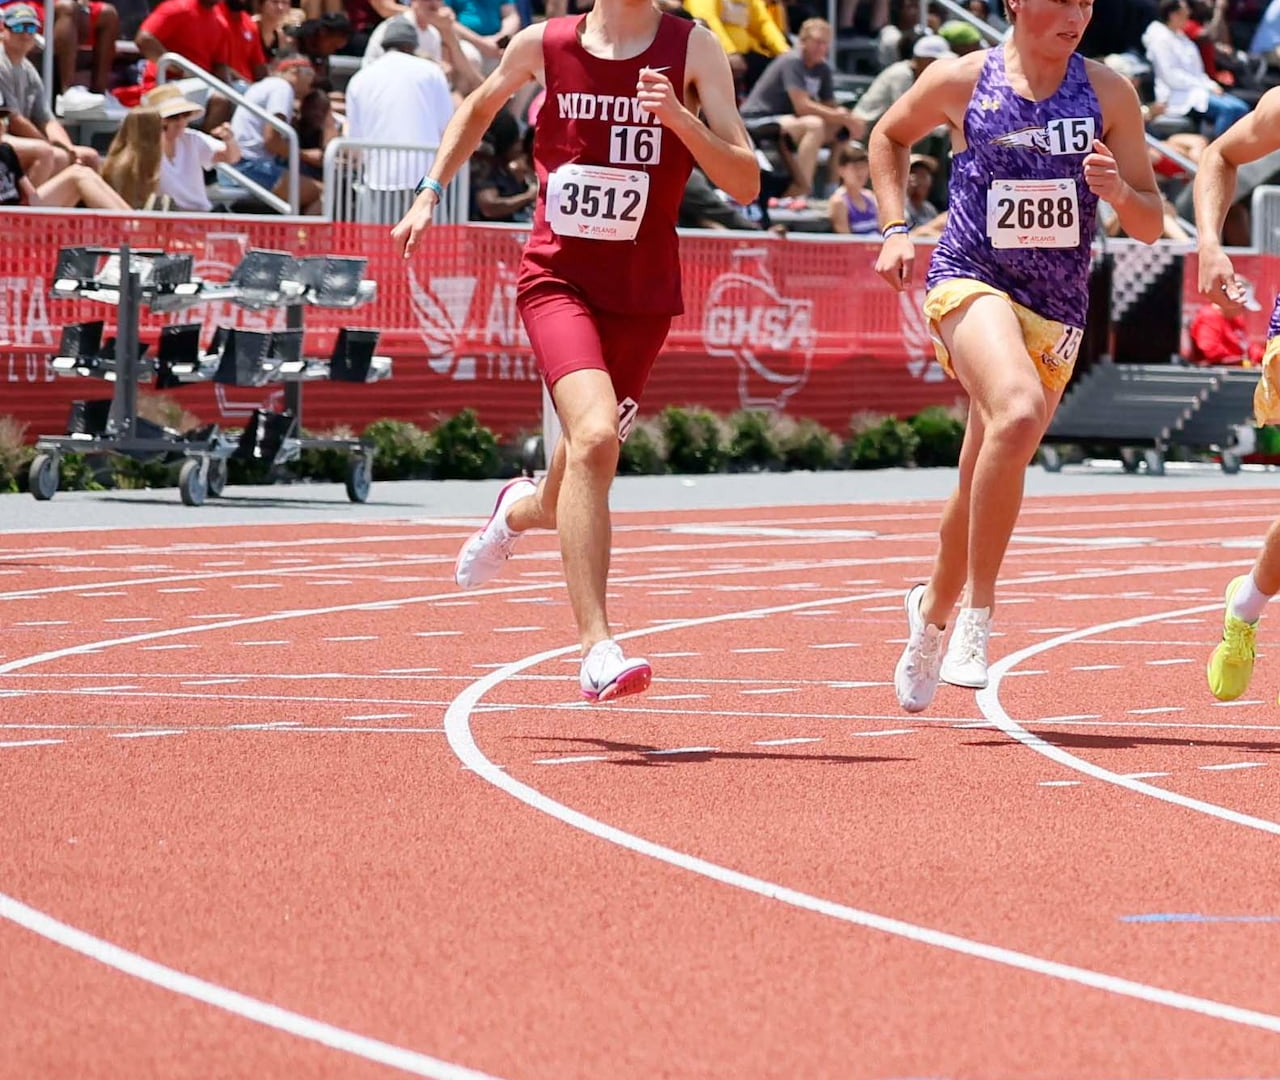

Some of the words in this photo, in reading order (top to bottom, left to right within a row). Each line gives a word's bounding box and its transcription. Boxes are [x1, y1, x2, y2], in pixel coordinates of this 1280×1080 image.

[557, 92, 661, 125] MIDTOW
[614, 127, 654, 163] 16
[1052, 120, 1089, 153] 15
[560, 182, 641, 222] 3512
[997, 197, 1074, 229] 2688
[707, 304, 813, 349] GHSA
[1056, 326, 1082, 361] 15
